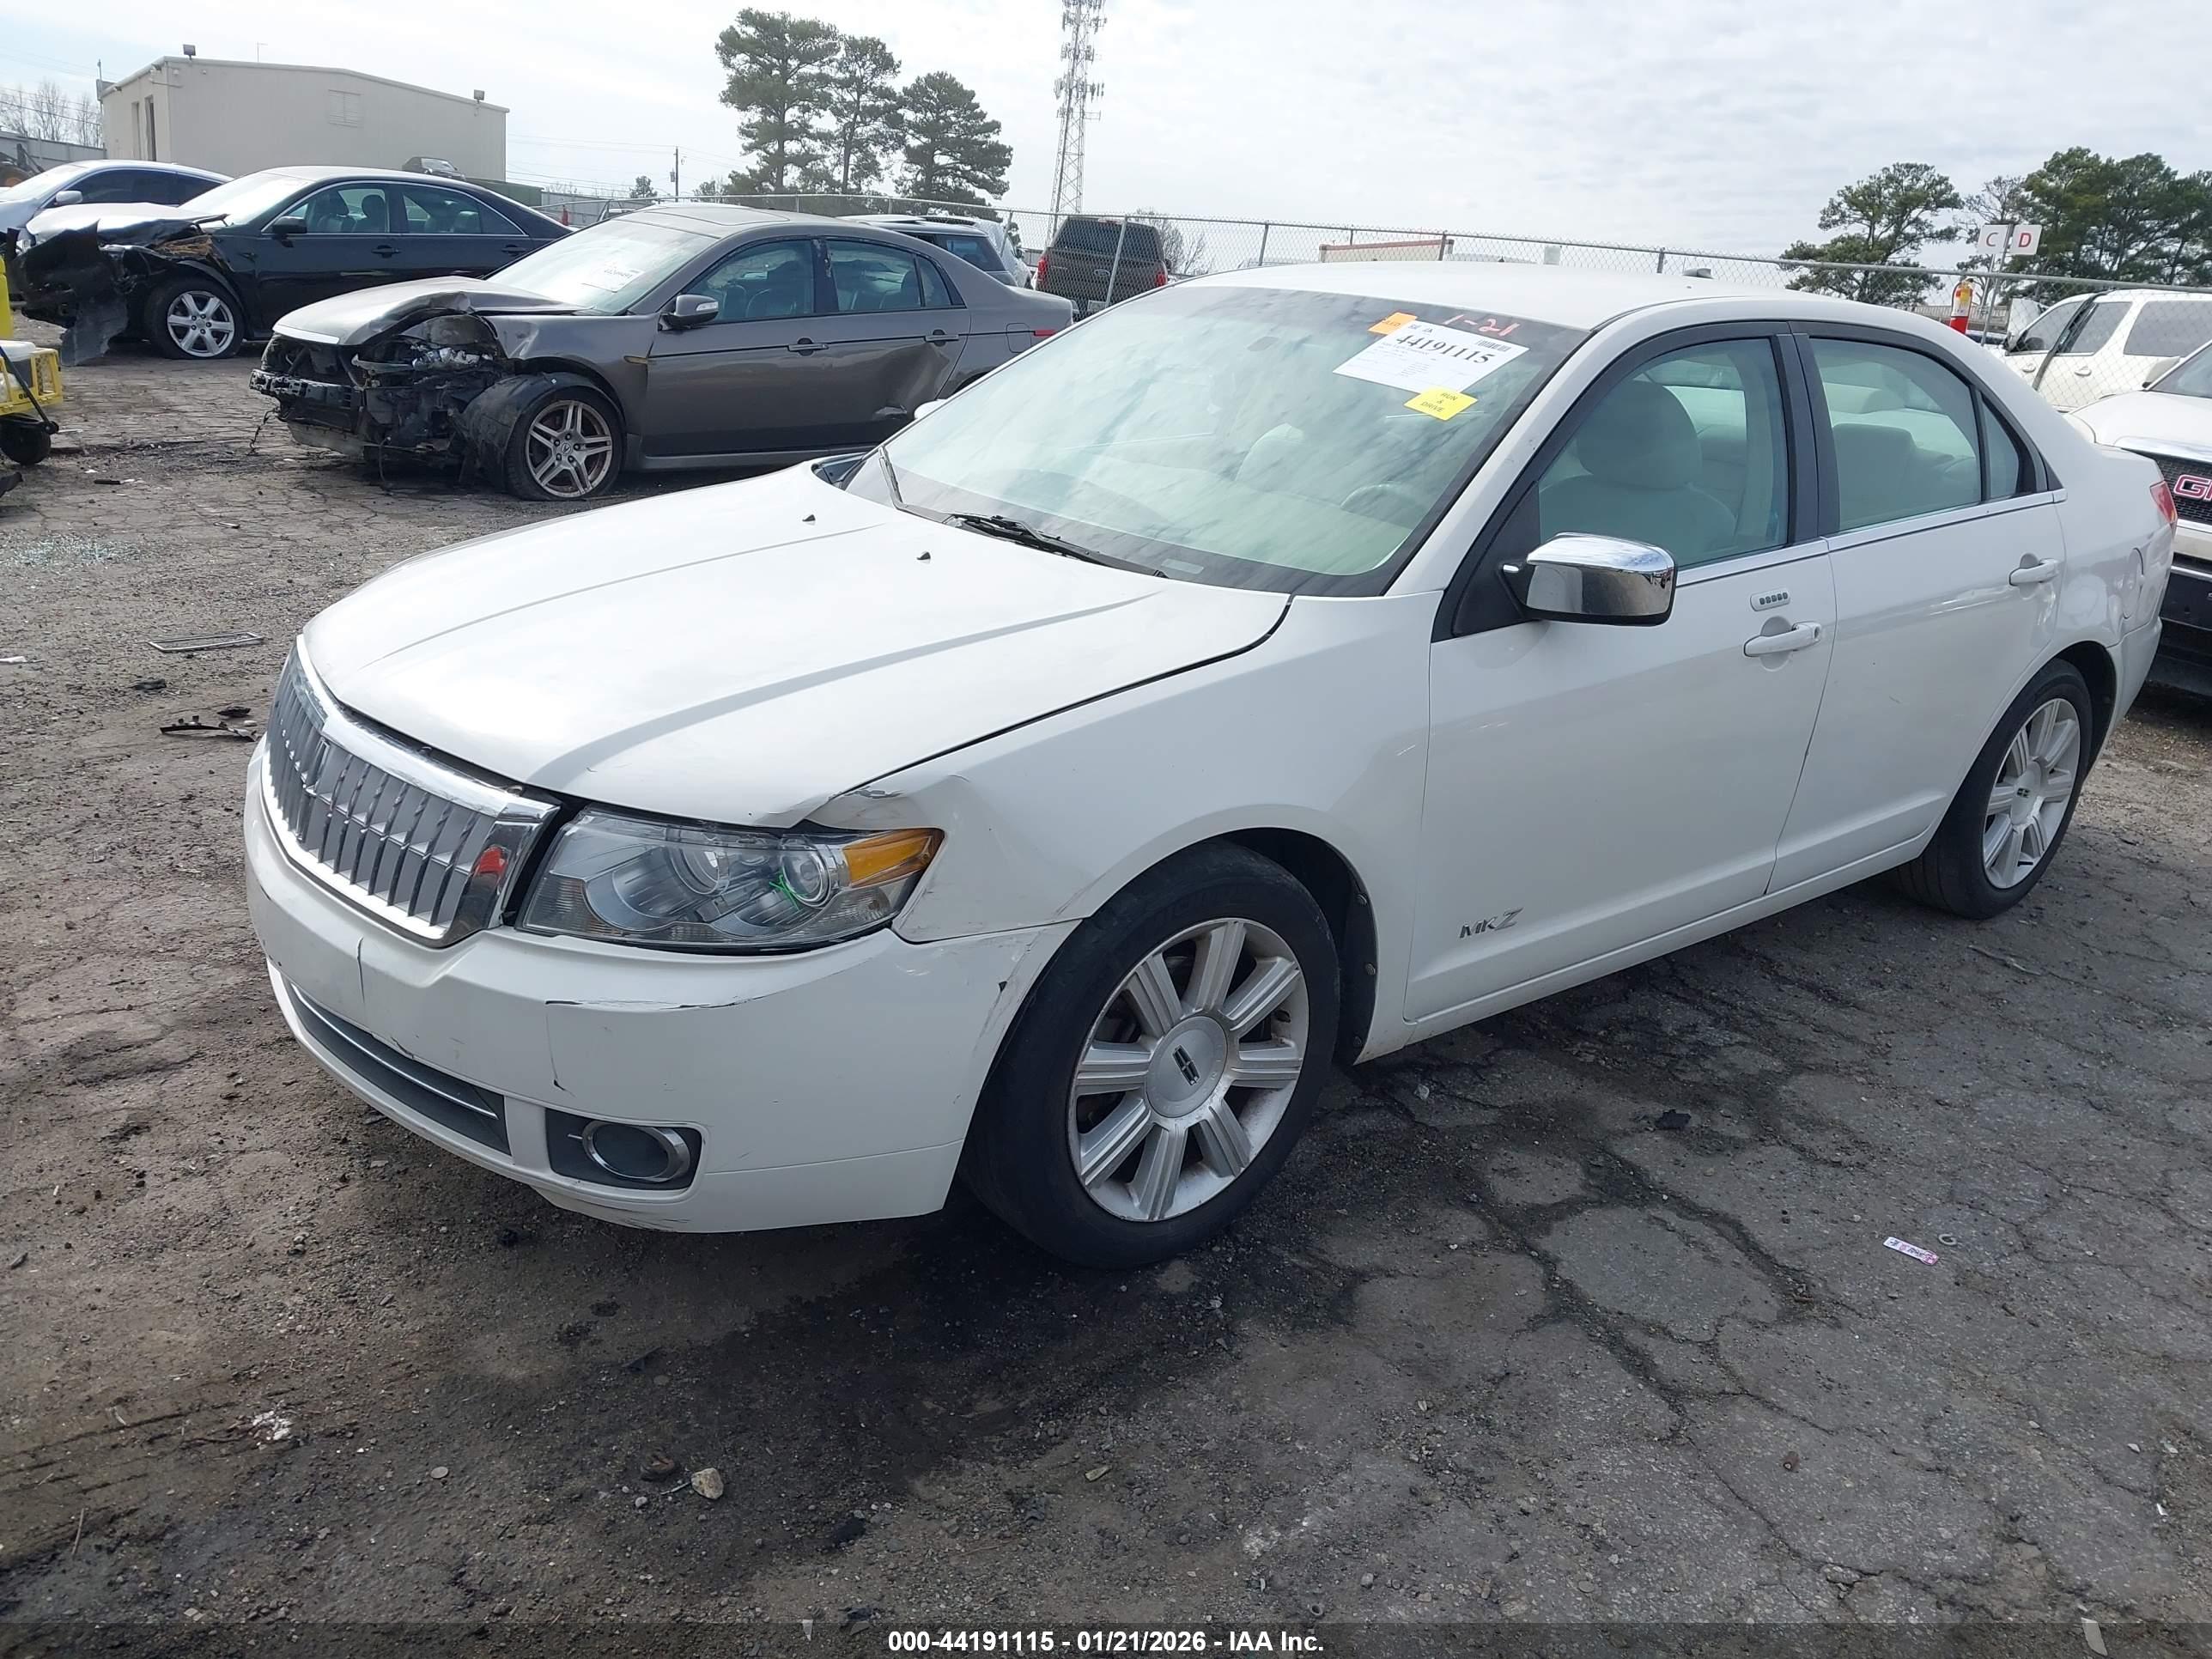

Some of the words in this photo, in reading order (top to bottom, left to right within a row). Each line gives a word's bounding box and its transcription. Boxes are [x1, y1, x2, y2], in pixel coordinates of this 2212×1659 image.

[1987, 233, 1998, 246] C
[2019, 234, 2032, 247] D
[1396, 336, 1494, 364] 44191115
[1441, 392, 1458, 401] RUN
[1420, 401, 1444, 412] DRIVE
[2173, 474, 2212, 501] G
[1460, 908, 1523, 938] MKZ
